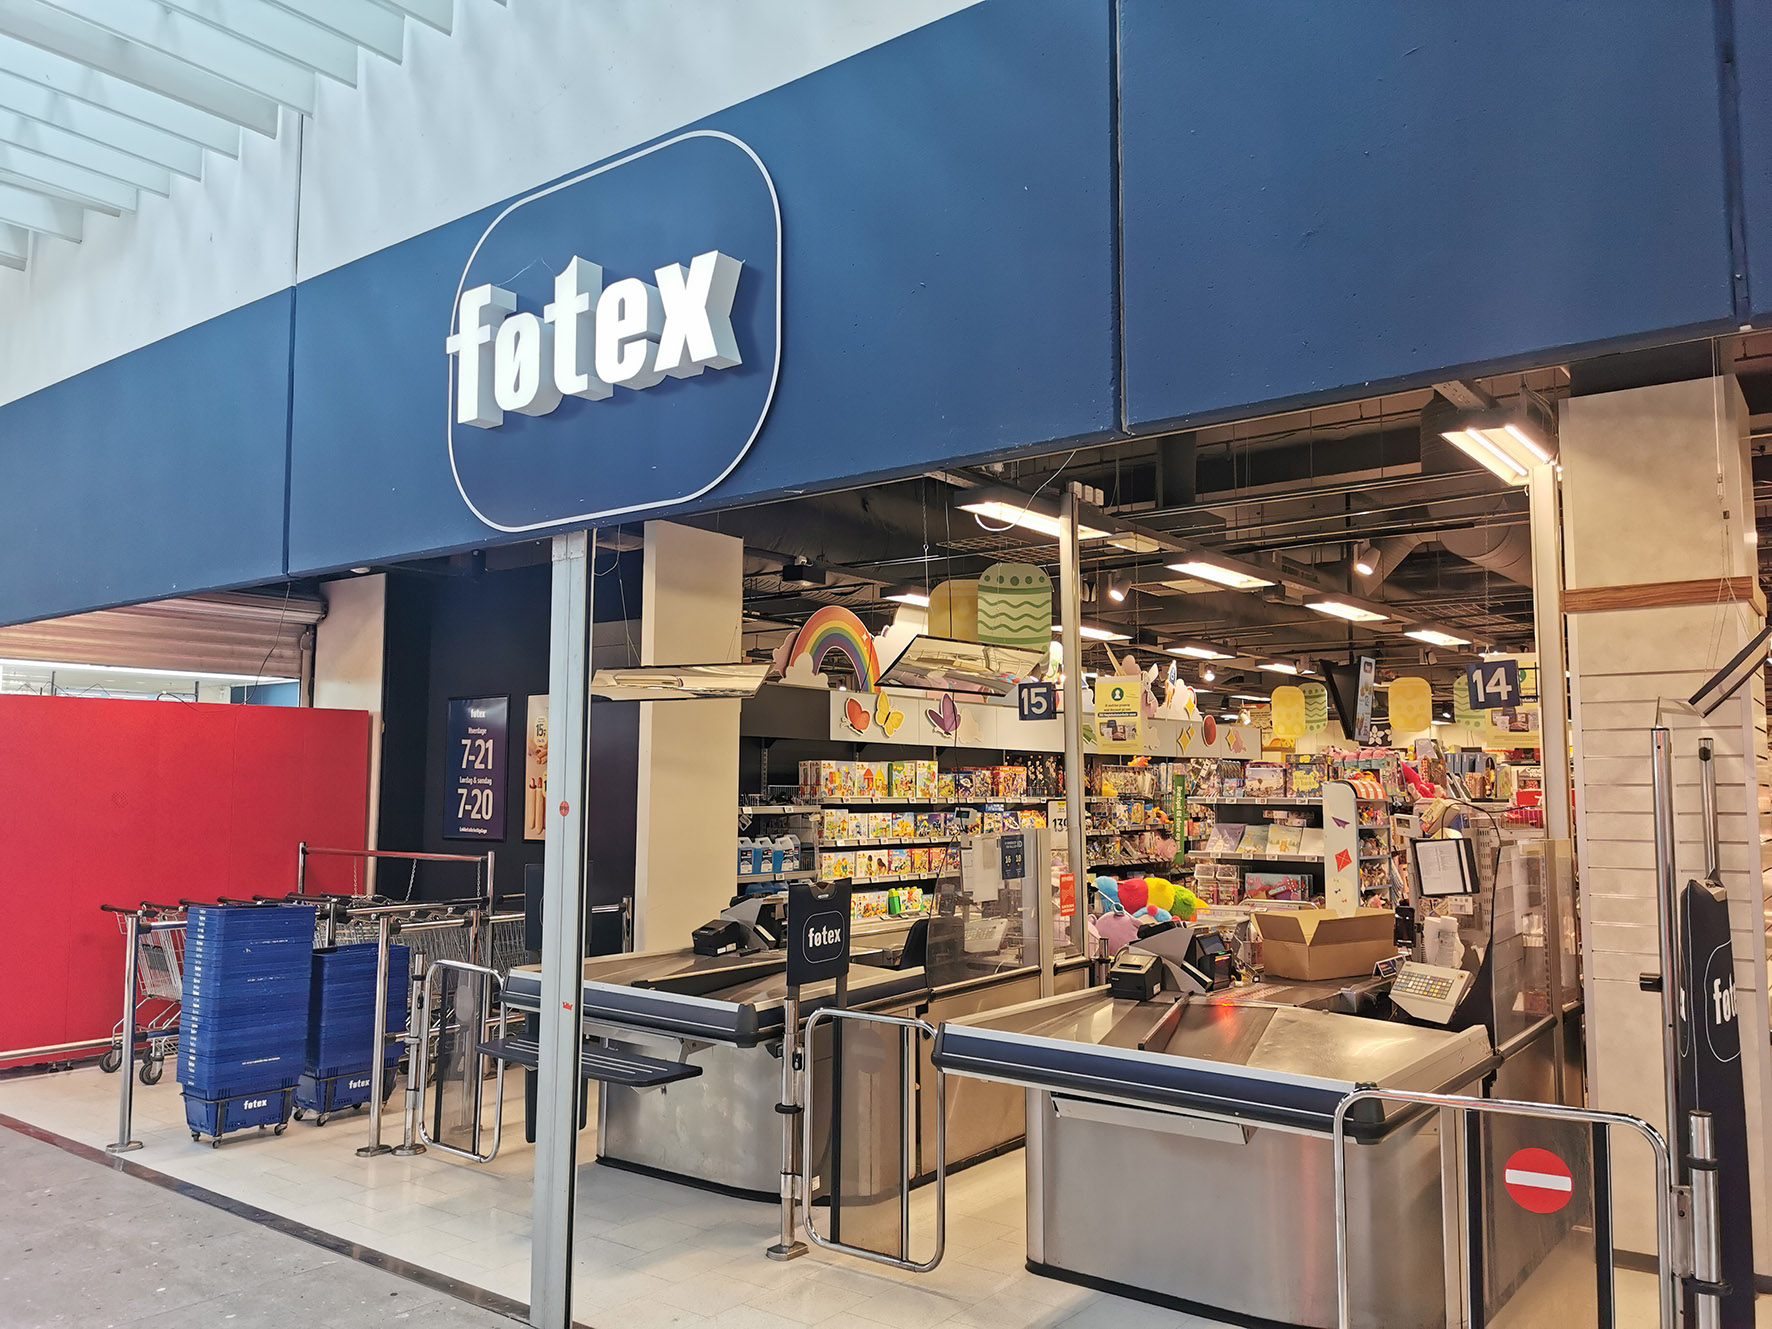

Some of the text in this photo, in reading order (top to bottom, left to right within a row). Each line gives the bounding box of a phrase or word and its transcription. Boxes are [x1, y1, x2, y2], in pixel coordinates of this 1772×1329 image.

[446, 250, 745, 429] føtex
[1472, 667, 1512, 702] 14
[1021, 687, 1047, 715] 15
[461, 739, 493, 769] 7-21
[457, 788, 493, 820] 7-20
[808, 925, 841, 947] føtex
[349, 1079, 370, 1090] føtex
[243, 1099, 268, 1110] føtex
